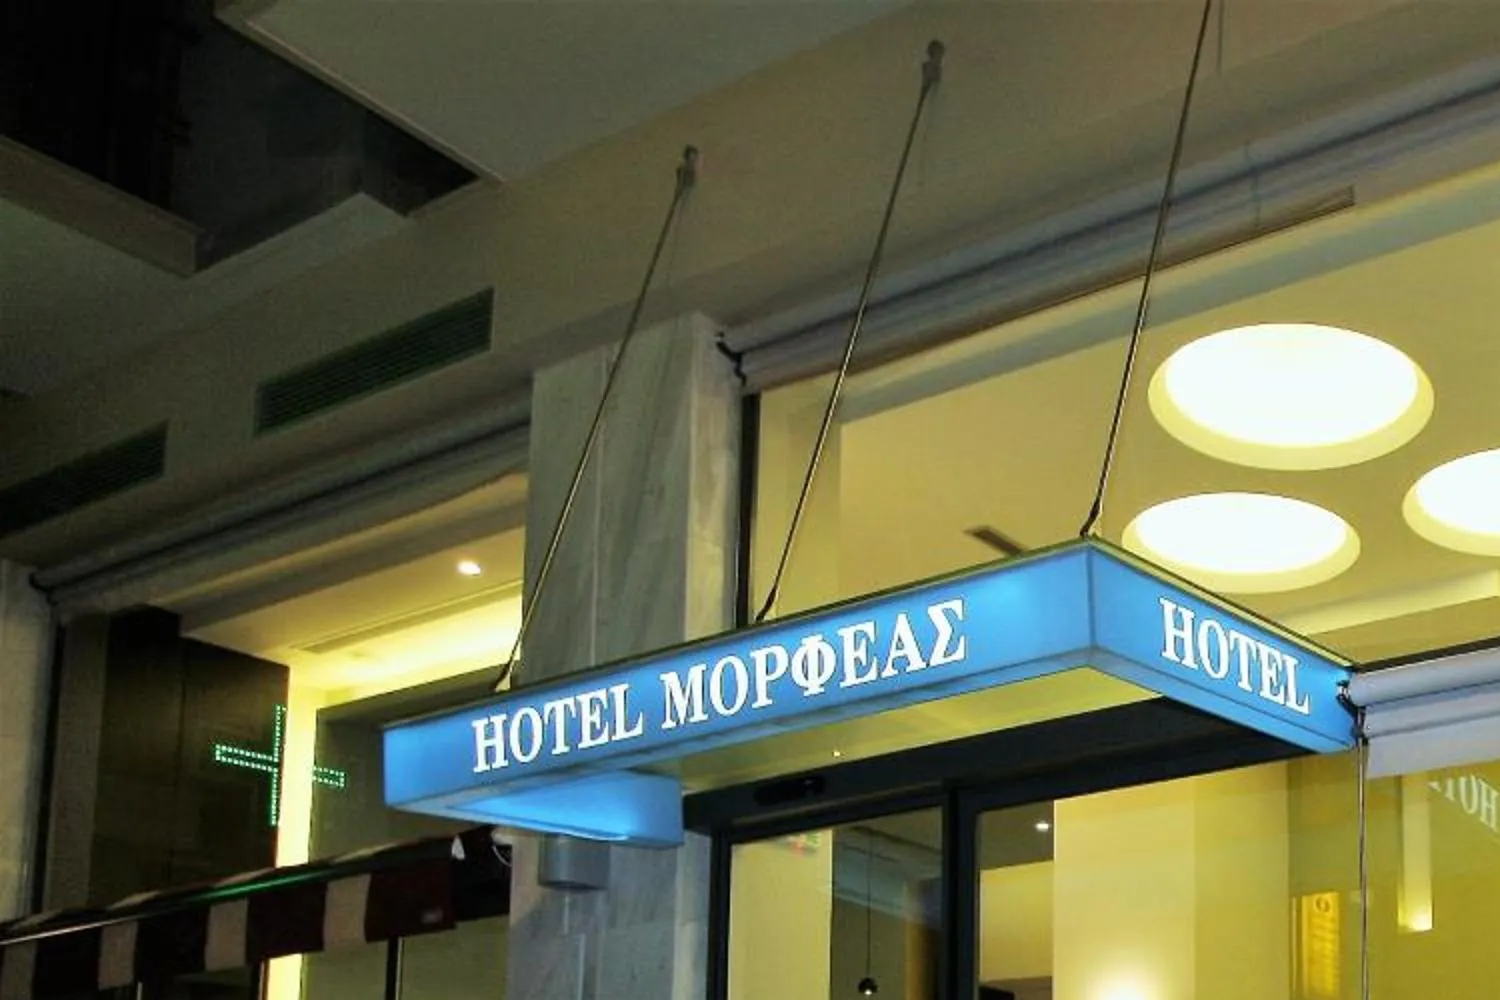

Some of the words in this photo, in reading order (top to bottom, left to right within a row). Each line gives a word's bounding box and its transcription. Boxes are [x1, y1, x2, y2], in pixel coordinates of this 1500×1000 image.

[473, 685, 643, 774] HOTEL
[660, 599, 967, 730] ΜΟΡΦΕΑΣ
[1159, 597, 1310, 715] HOTEL
